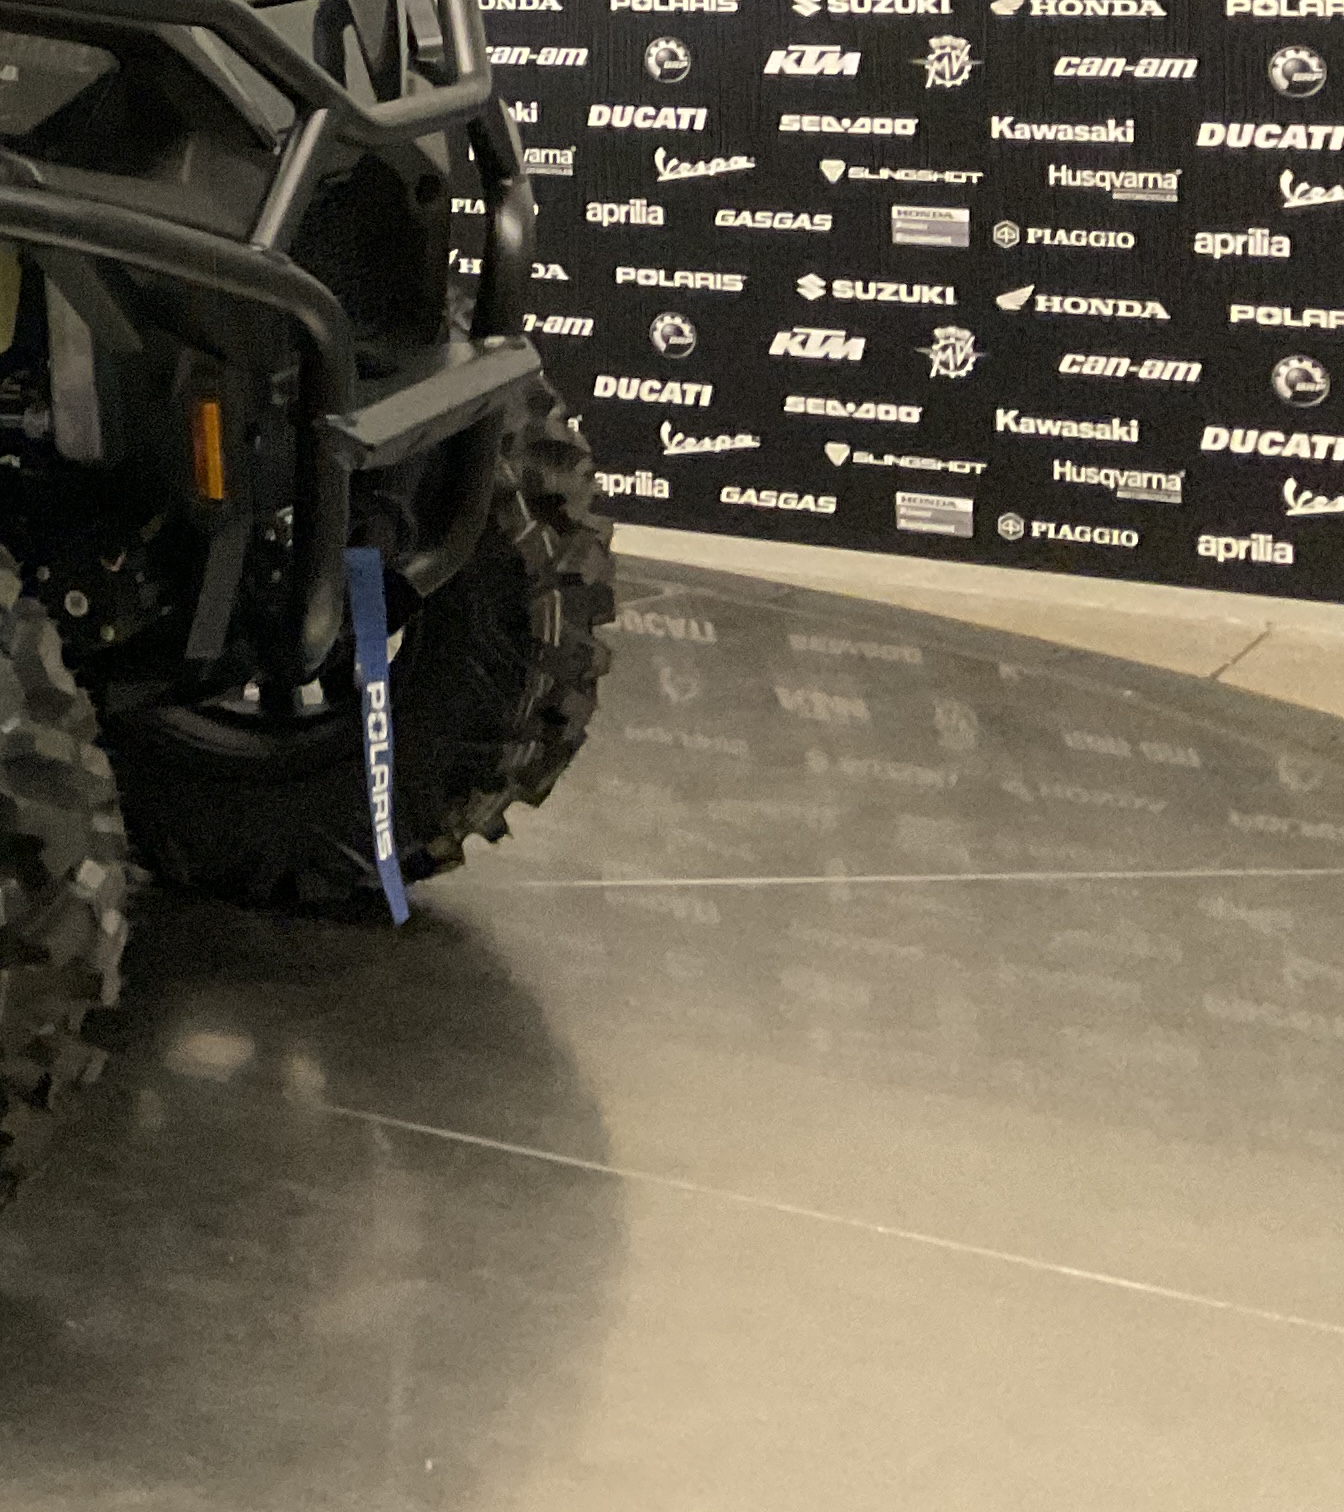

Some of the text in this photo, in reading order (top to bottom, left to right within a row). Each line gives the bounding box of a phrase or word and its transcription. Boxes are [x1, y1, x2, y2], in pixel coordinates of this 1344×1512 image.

[1030, 0, 1166, 16] HONDA
[763, 44, 861, 77] KTM
[1054, 56, 1198, 81] can-am
[587, 104, 708, 131] DUCATI
[991, 116, 1134, 143] Kawasaki
[654, 147, 756, 182] Vespa
[1049, 164, 1178, 191] Husqvarna
[586, 198, 664, 227] aprilia
[715, 209, 833, 232] GASGAS
[1027, 228, 1134, 248] PIAGGIO
[1194, 227, 1290, 259] aprilia
[616, 266, 748, 292] POLARIS
[832, 280, 956, 305] SUZUKI
[1035, 295, 1170, 319] HONDA
[769, 326, 866, 361] KTM
[1058, 353, 1202, 384] can-am
[593, 375, 713, 407] DUCATI
[660, 420, 760, 456] Vespa
[996, 407, 1139, 442] Kawasaki
[1054, 460, 1182, 491] Husqvarna
[720, 486, 837, 514] GASGAS
[1032, 521, 1138, 547] PIAGGIO
[1197, 533, 1294, 564] aprilia
[366, 680, 394, 857] POLARIS
